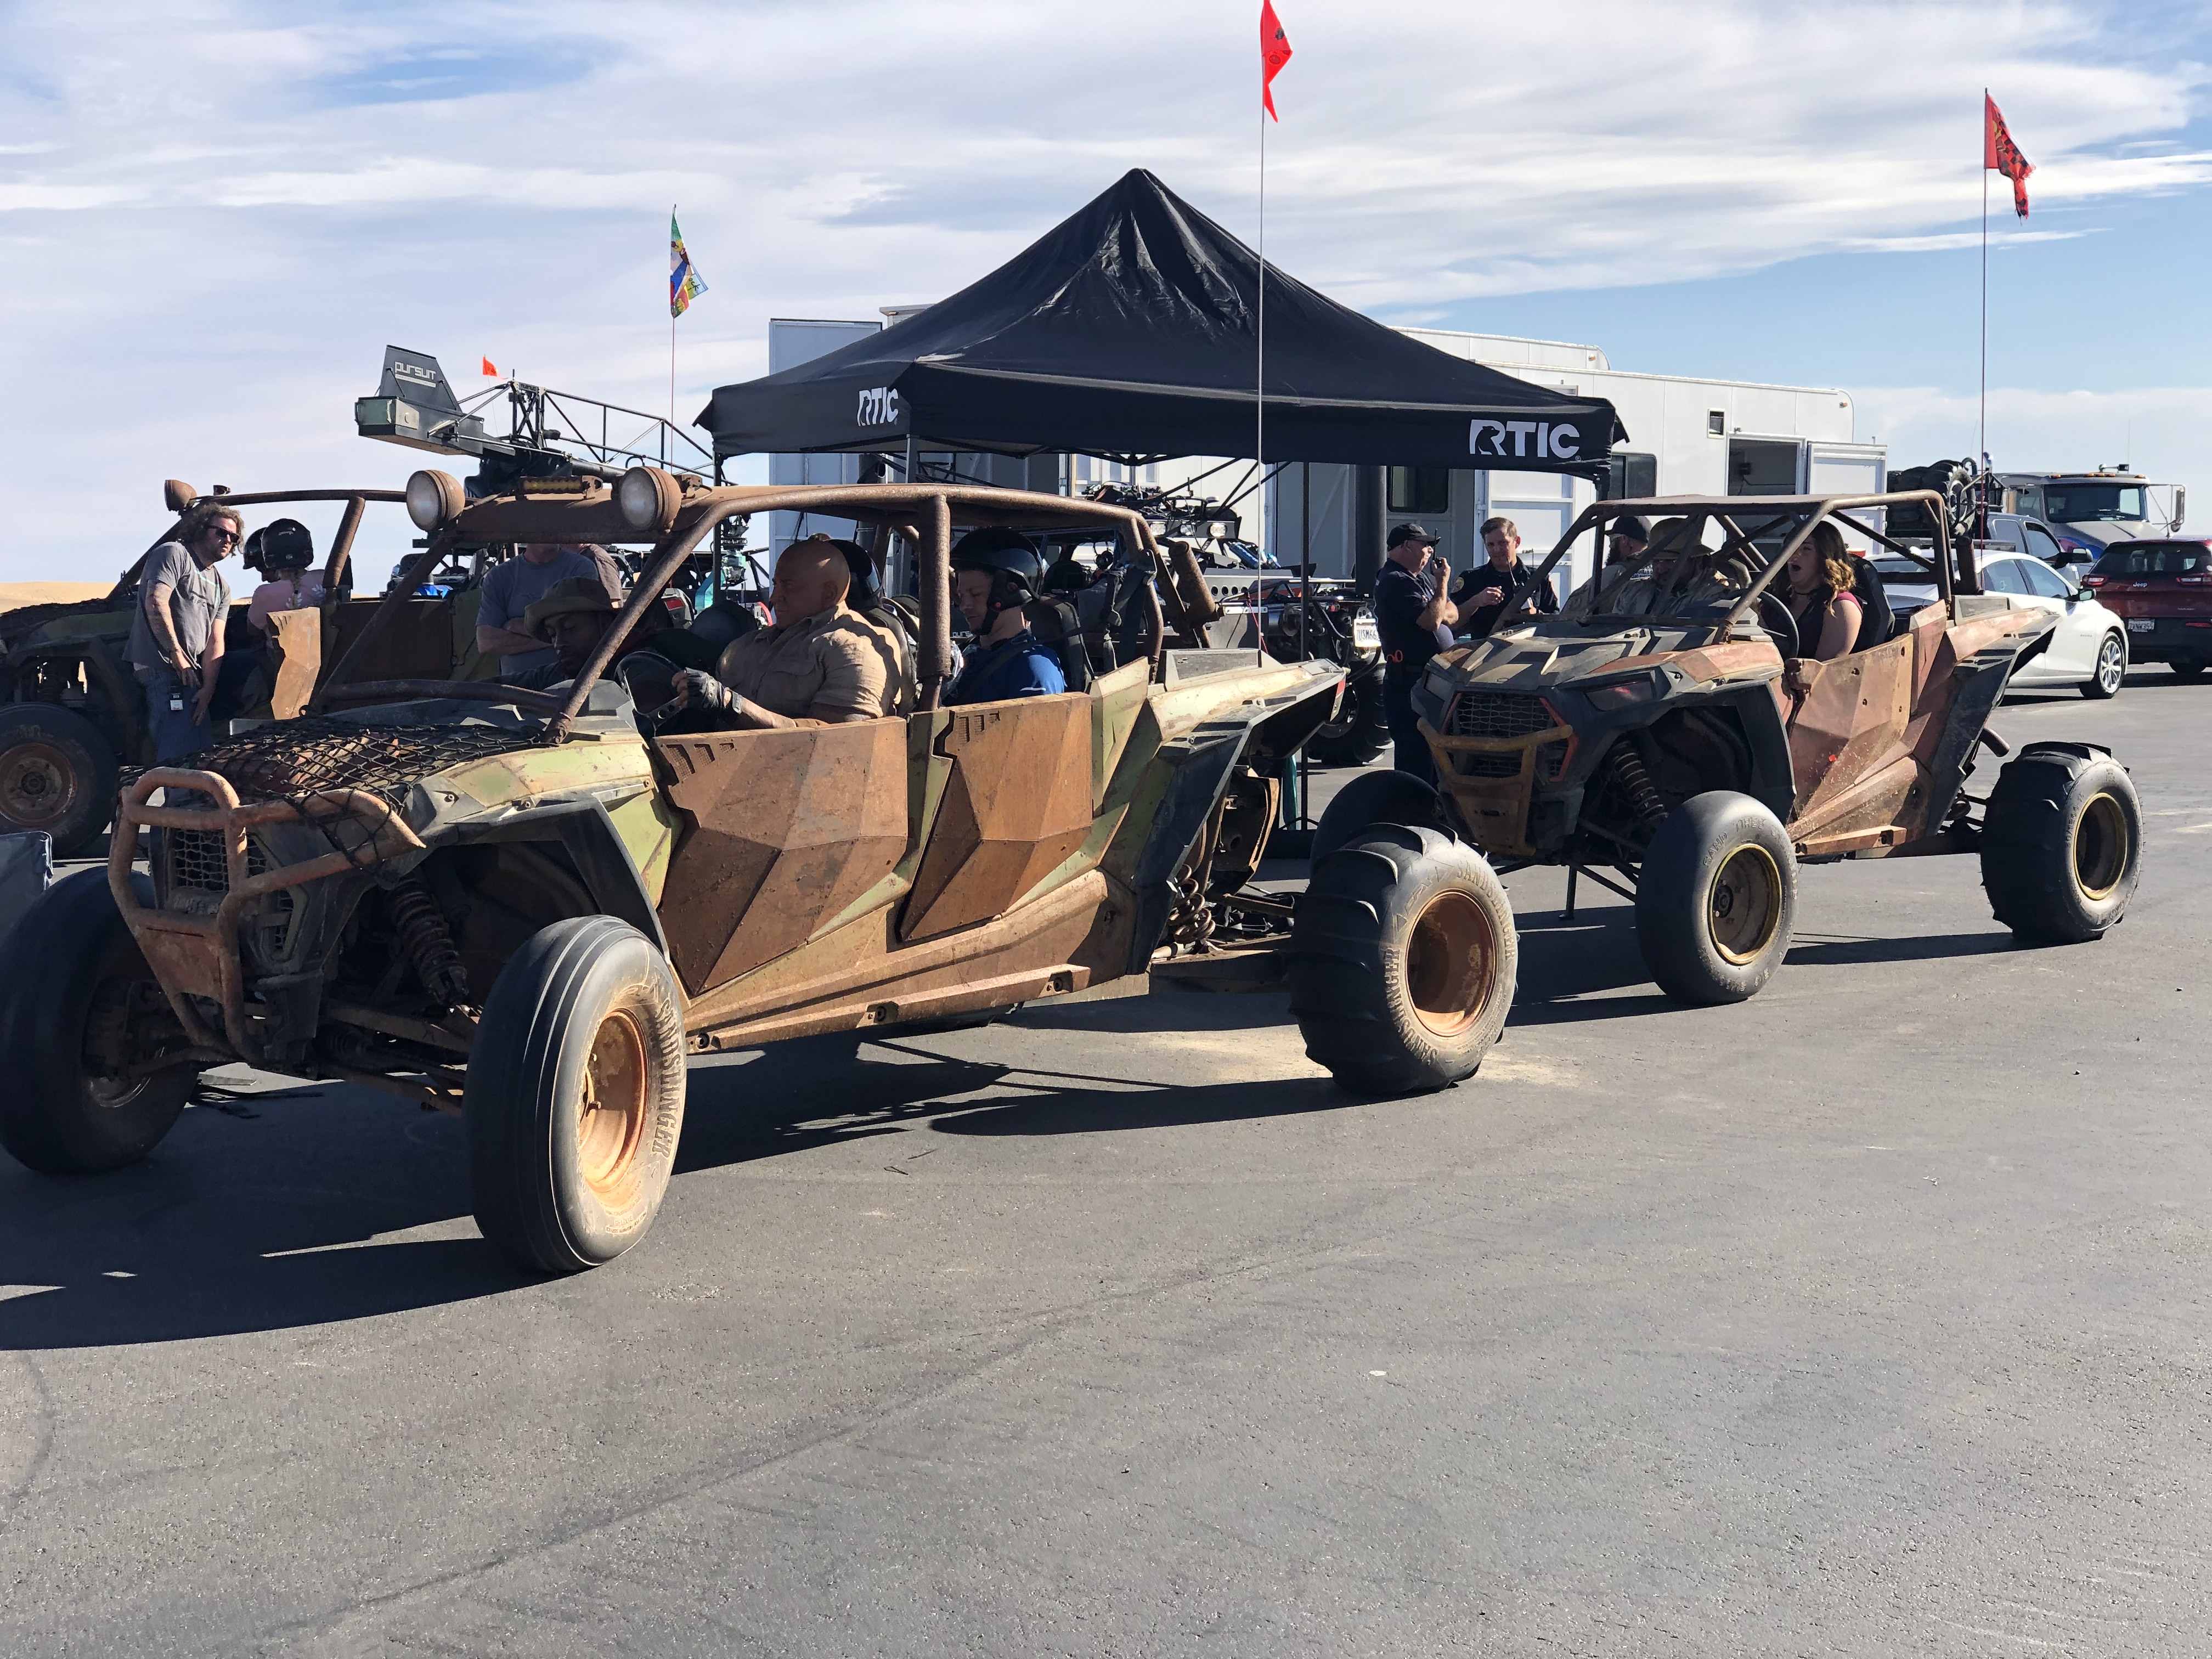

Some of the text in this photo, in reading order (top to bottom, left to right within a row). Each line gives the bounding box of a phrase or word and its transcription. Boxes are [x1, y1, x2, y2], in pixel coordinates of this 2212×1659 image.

[857, 386, 899, 427] RTIC
[1469, 419, 1580, 459] RTIC
[1356, 629, 1378, 641] 7USM66
[1703, 832, 1729, 867] SAND
[1733, 816, 1767, 832] TIRES
[1457, 860, 1516, 960] SANDSLINGER
[1384, 947, 1438, 1065] SANDSLINGER
[652, 997, 682, 1159] SANDSLINGER
